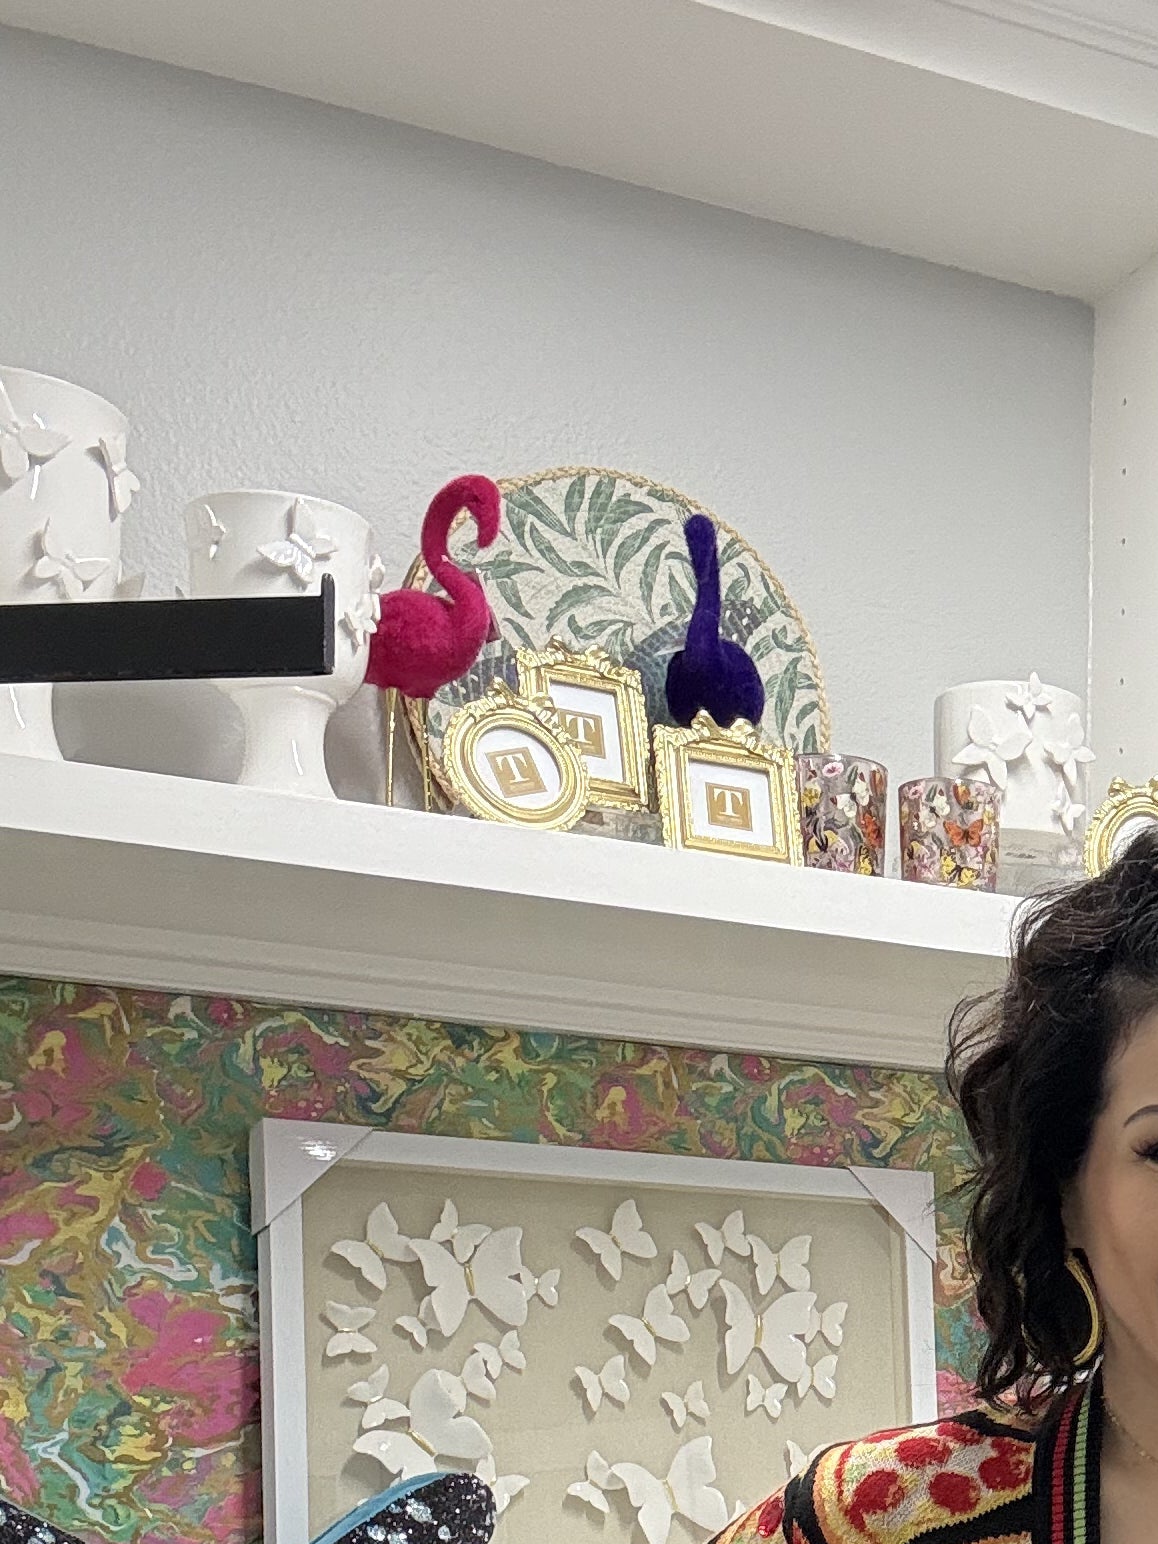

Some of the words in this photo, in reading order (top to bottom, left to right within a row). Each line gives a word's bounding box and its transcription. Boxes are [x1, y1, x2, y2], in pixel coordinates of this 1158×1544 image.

[565, 714, 595, 744] T
[495, 753, 530, 784] T
[713, 787, 743, 817] T
